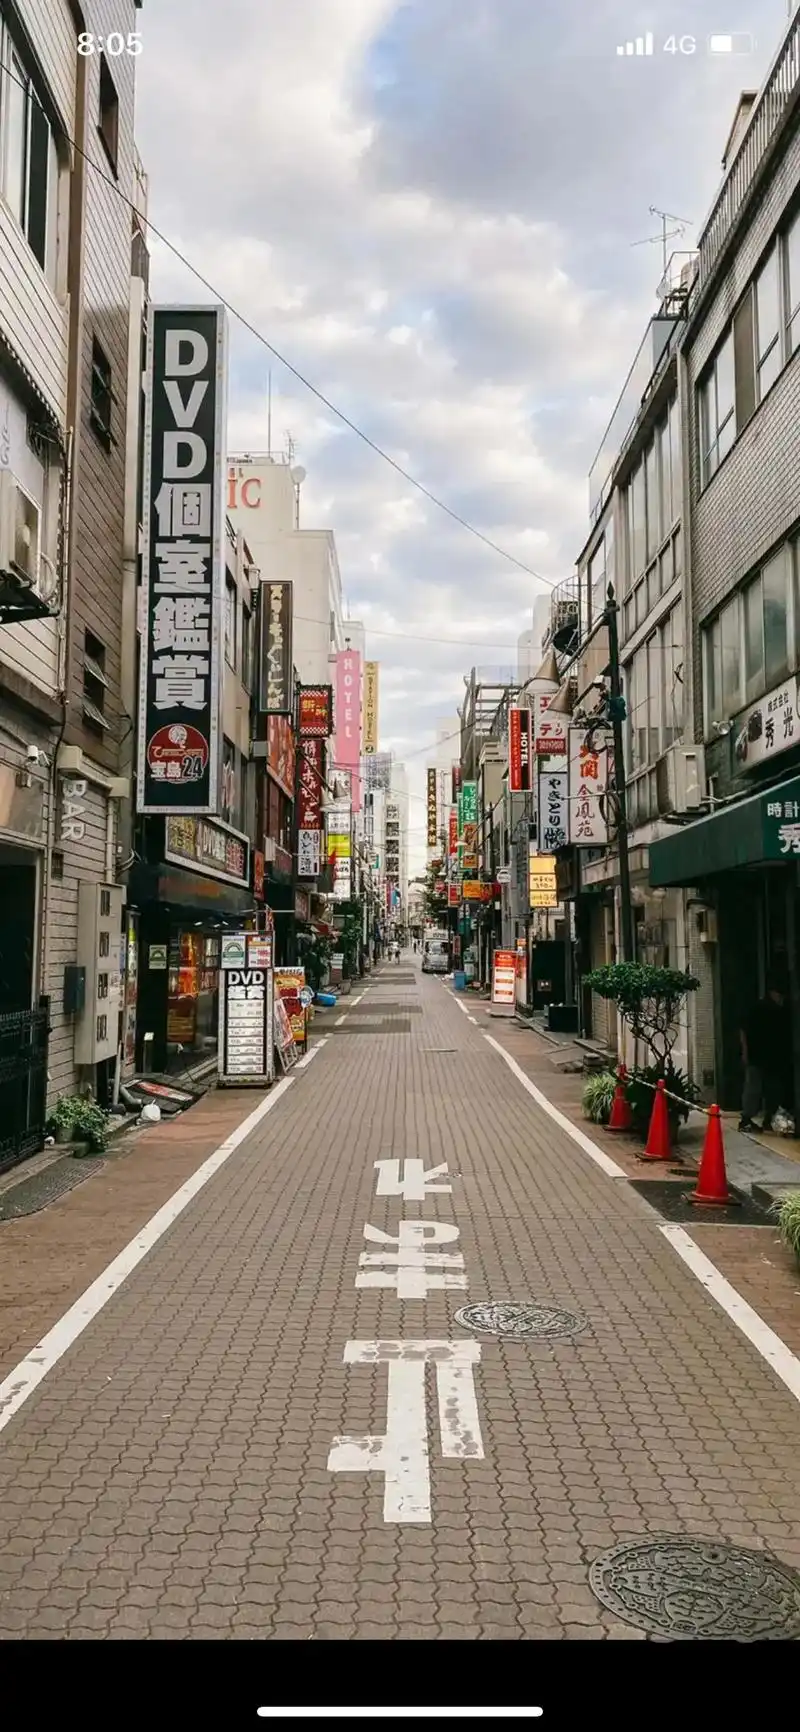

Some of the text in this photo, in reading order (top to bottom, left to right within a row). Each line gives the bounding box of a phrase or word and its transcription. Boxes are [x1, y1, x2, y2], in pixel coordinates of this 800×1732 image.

[151, 329, 211, 711] DVD個室鑑賞
[343, 658, 353, 738] HOTEL
[521, 732, 529, 767] HOTEL
[765, 706, 794, 749] 秀光
[62, 779, 87, 841] BAR
[547, 777, 562, 828] やきとり
[227, 970, 265, 985] DVD
